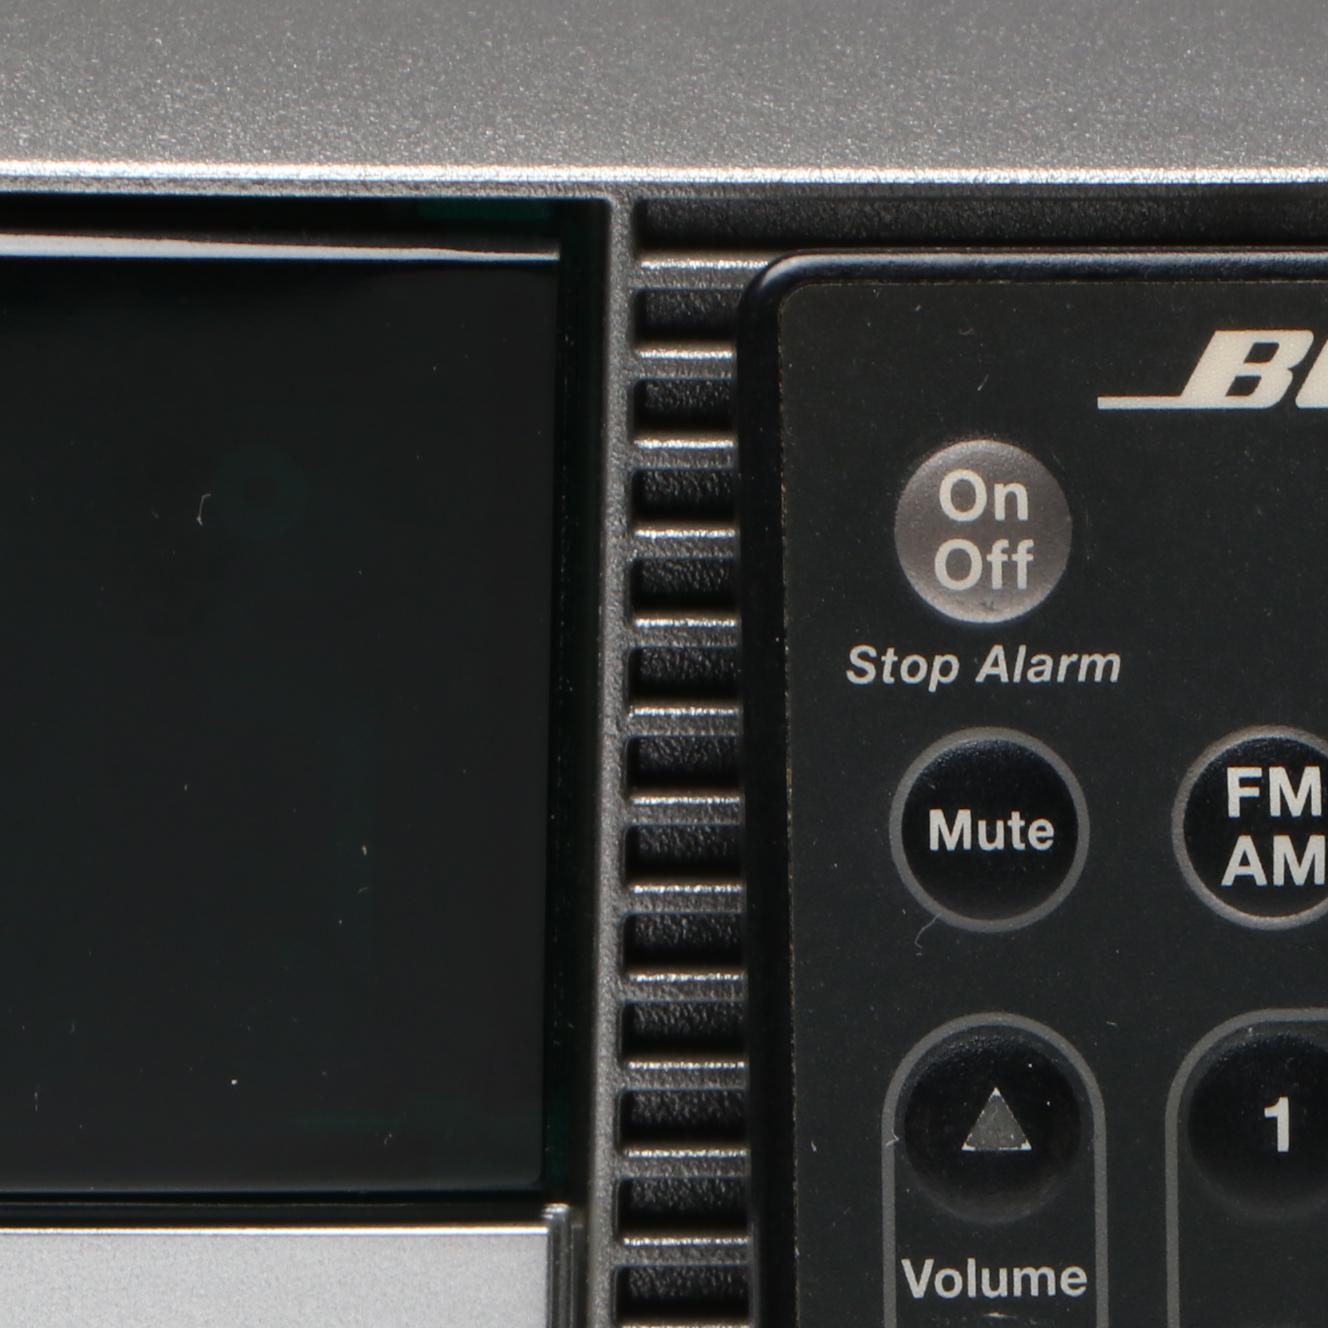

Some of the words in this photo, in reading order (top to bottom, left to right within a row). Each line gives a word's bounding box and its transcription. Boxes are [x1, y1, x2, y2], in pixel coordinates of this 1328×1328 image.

[938, 468, 1029, 522] On
[934, 538, 1034, 592] Off
[846, 644, 960, 693] Stop
[975, 644, 1121, 683] Alarm
[1226, 766, 1322, 818] FM
[929, 809, 1055, 851] Mute
[1221, 834, 1326, 886] AM
[1264, 1096, 1290, 1152] 1
[901, 1257, 1088, 1299] Volume
